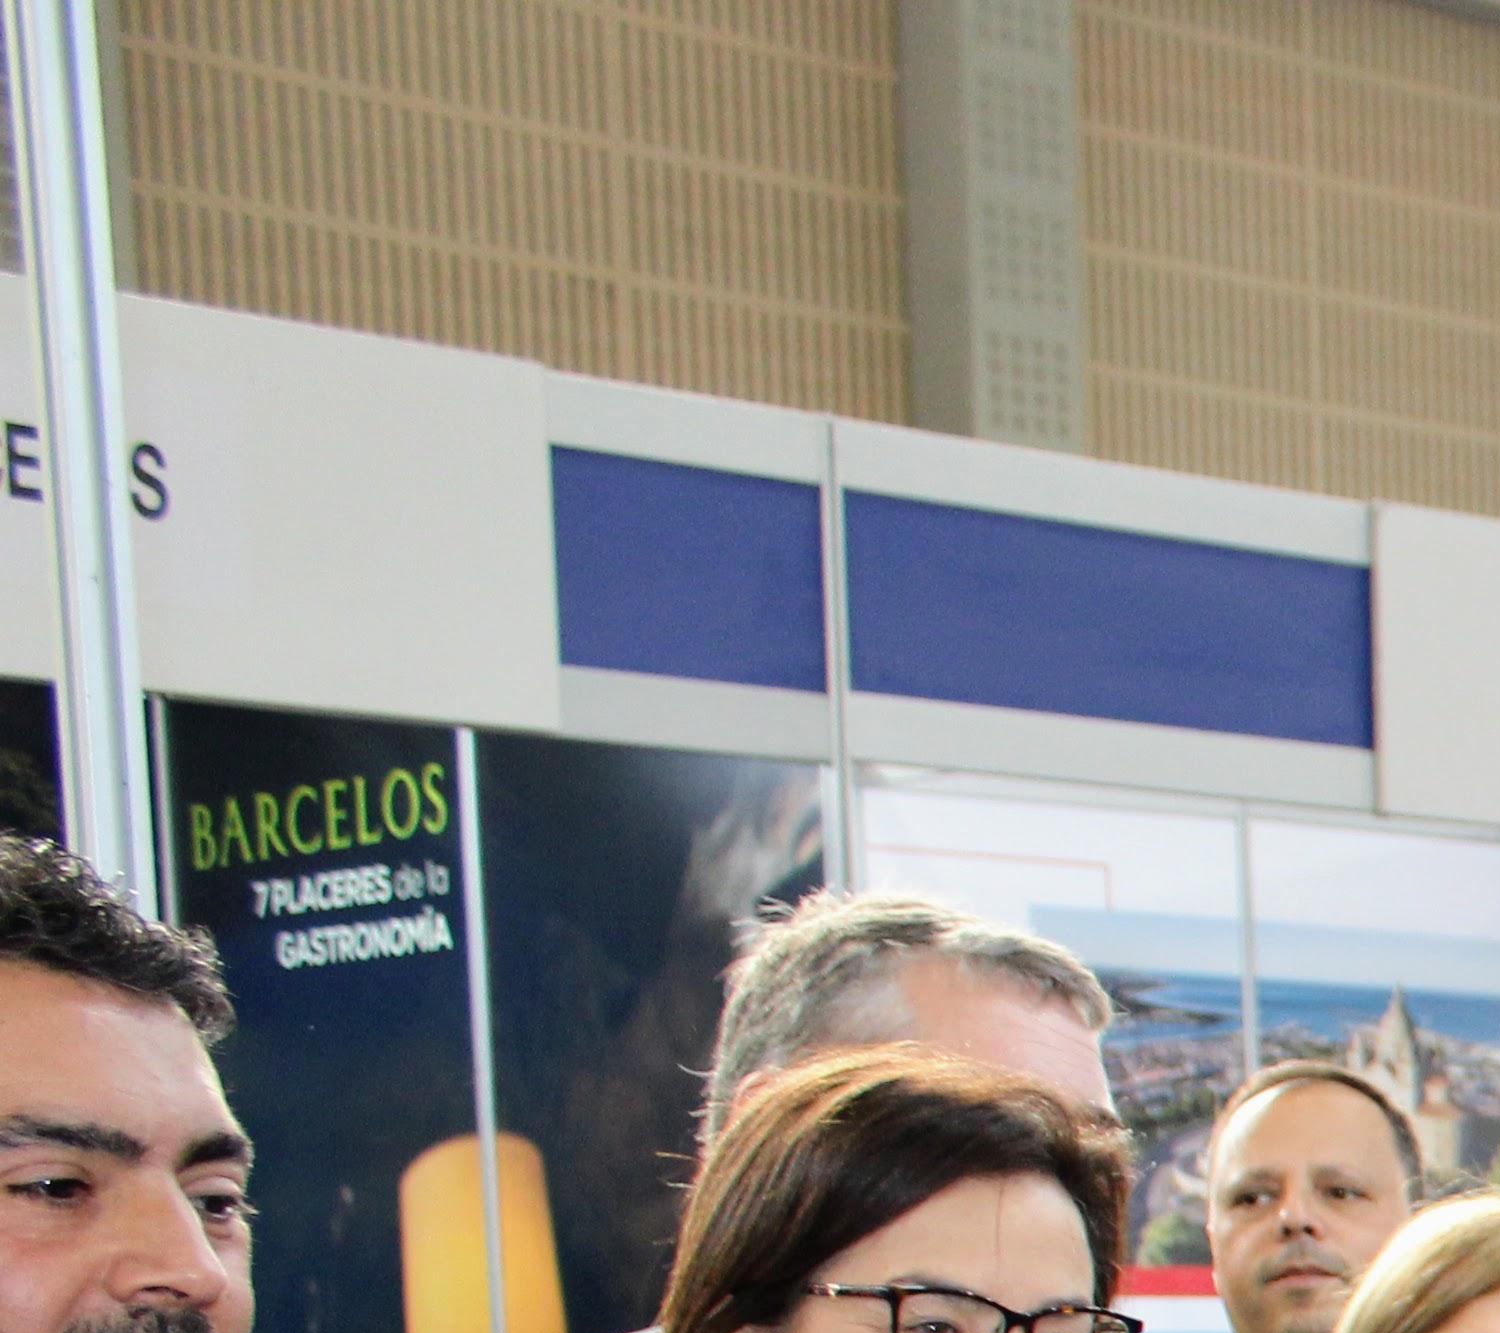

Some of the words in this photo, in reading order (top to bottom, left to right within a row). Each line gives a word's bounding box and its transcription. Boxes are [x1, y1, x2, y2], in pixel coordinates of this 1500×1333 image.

[189, 762, 449, 871] BARCELOS
[251, 878, 272, 920] 7
[271, 864, 391, 914] PLACERES
[393, 870, 424, 900] de
[424, 860, 451, 897] la
[274, 905, 455, 970] GASTRONOMÍA
